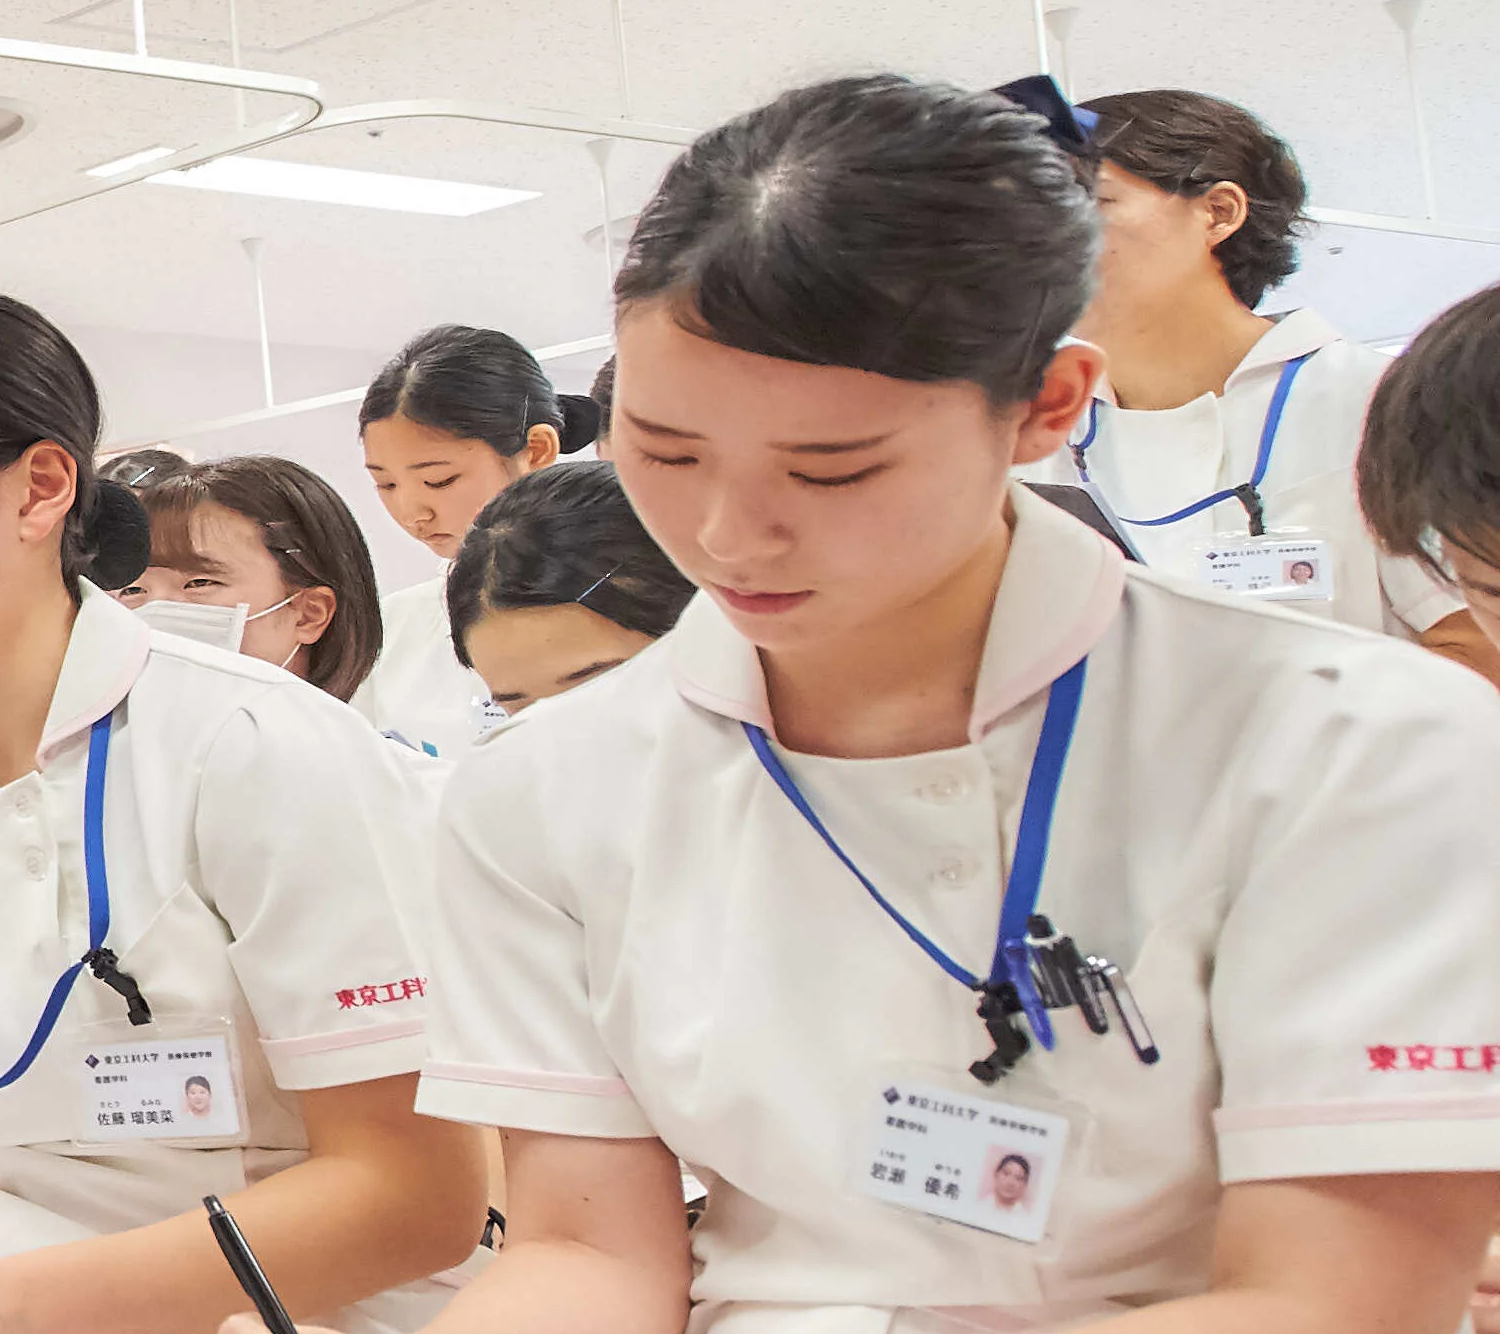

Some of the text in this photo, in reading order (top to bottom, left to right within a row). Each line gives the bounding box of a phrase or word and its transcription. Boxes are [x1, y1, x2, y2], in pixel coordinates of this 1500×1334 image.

[334, 976, 427, 1011] 東京工科
[96, 1112, 125, 1127] 佐藤
